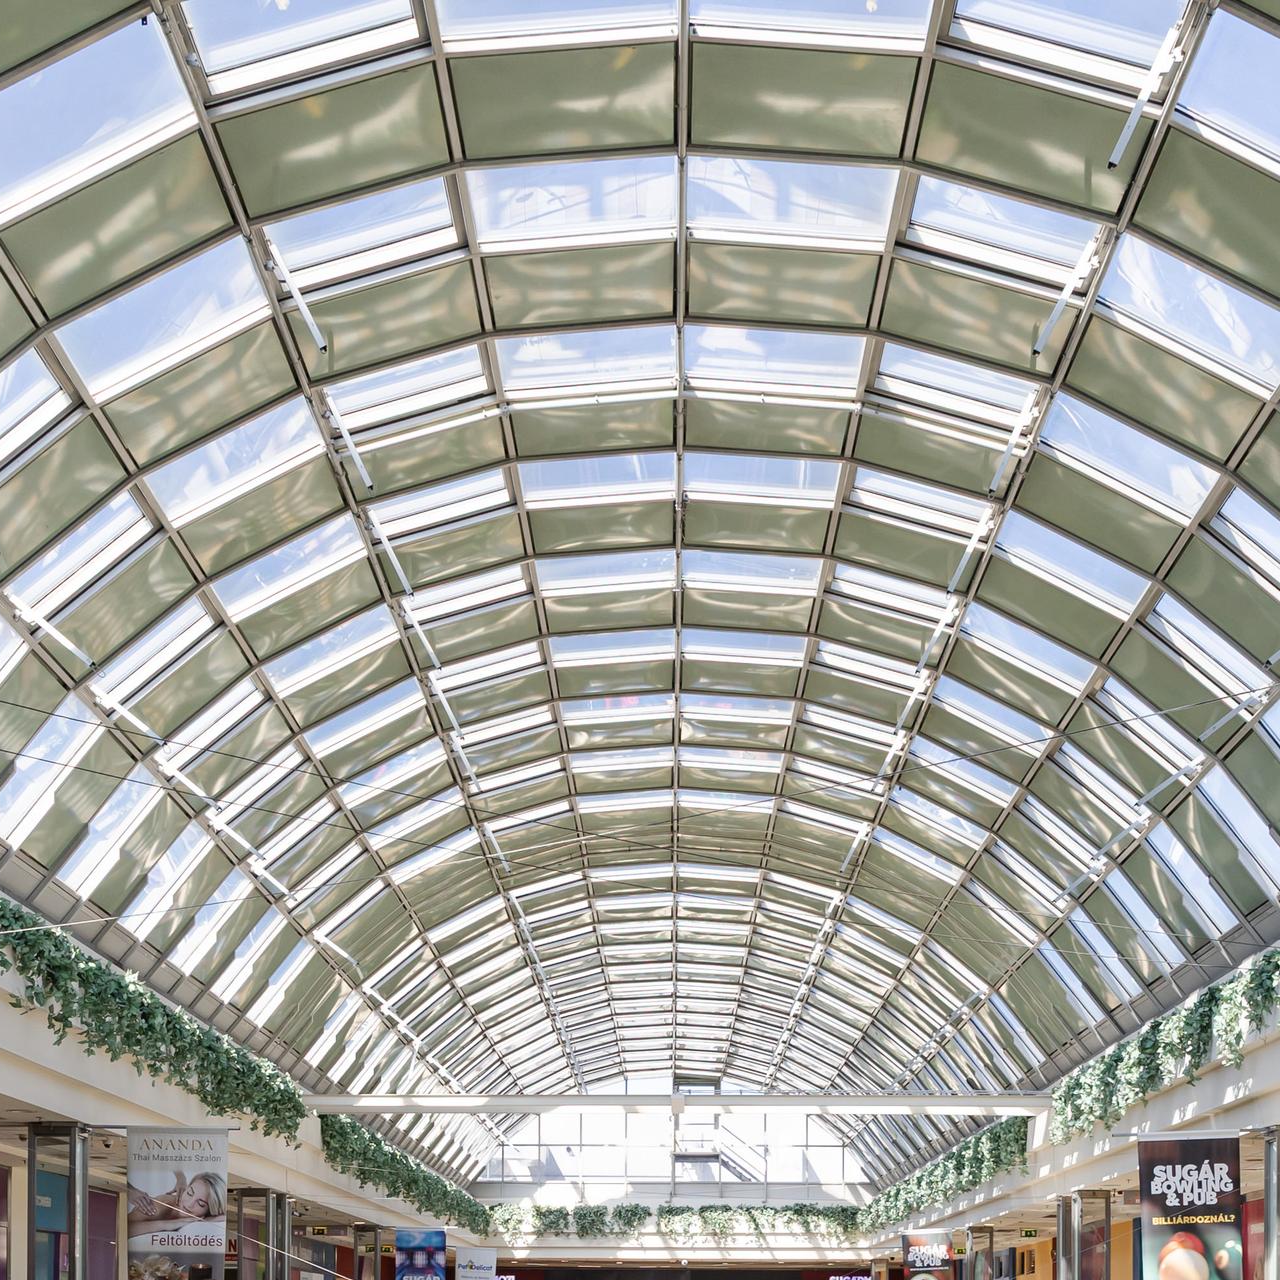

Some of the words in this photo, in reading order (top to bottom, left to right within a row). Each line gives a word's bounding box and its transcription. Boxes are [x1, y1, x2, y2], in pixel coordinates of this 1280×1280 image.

[140, 1139, 213, 1151] ANANDA
[133, 1153, 150, 1161] Thai
[195, 1154, 222, 1162] Szalon
[1153, 1160, 1232, 1182] SUGÁR
[1151, 1180, 1233, 1194] BOWLING
[1166, 1192, 1180, 1206] &
[1183, 1191, 1218, 1206] PUB
[1152, 1213, 1235, 1225] BILLIÁRDOZNÁL?
[151, 1235, 223, 1247] Feltöltődés
